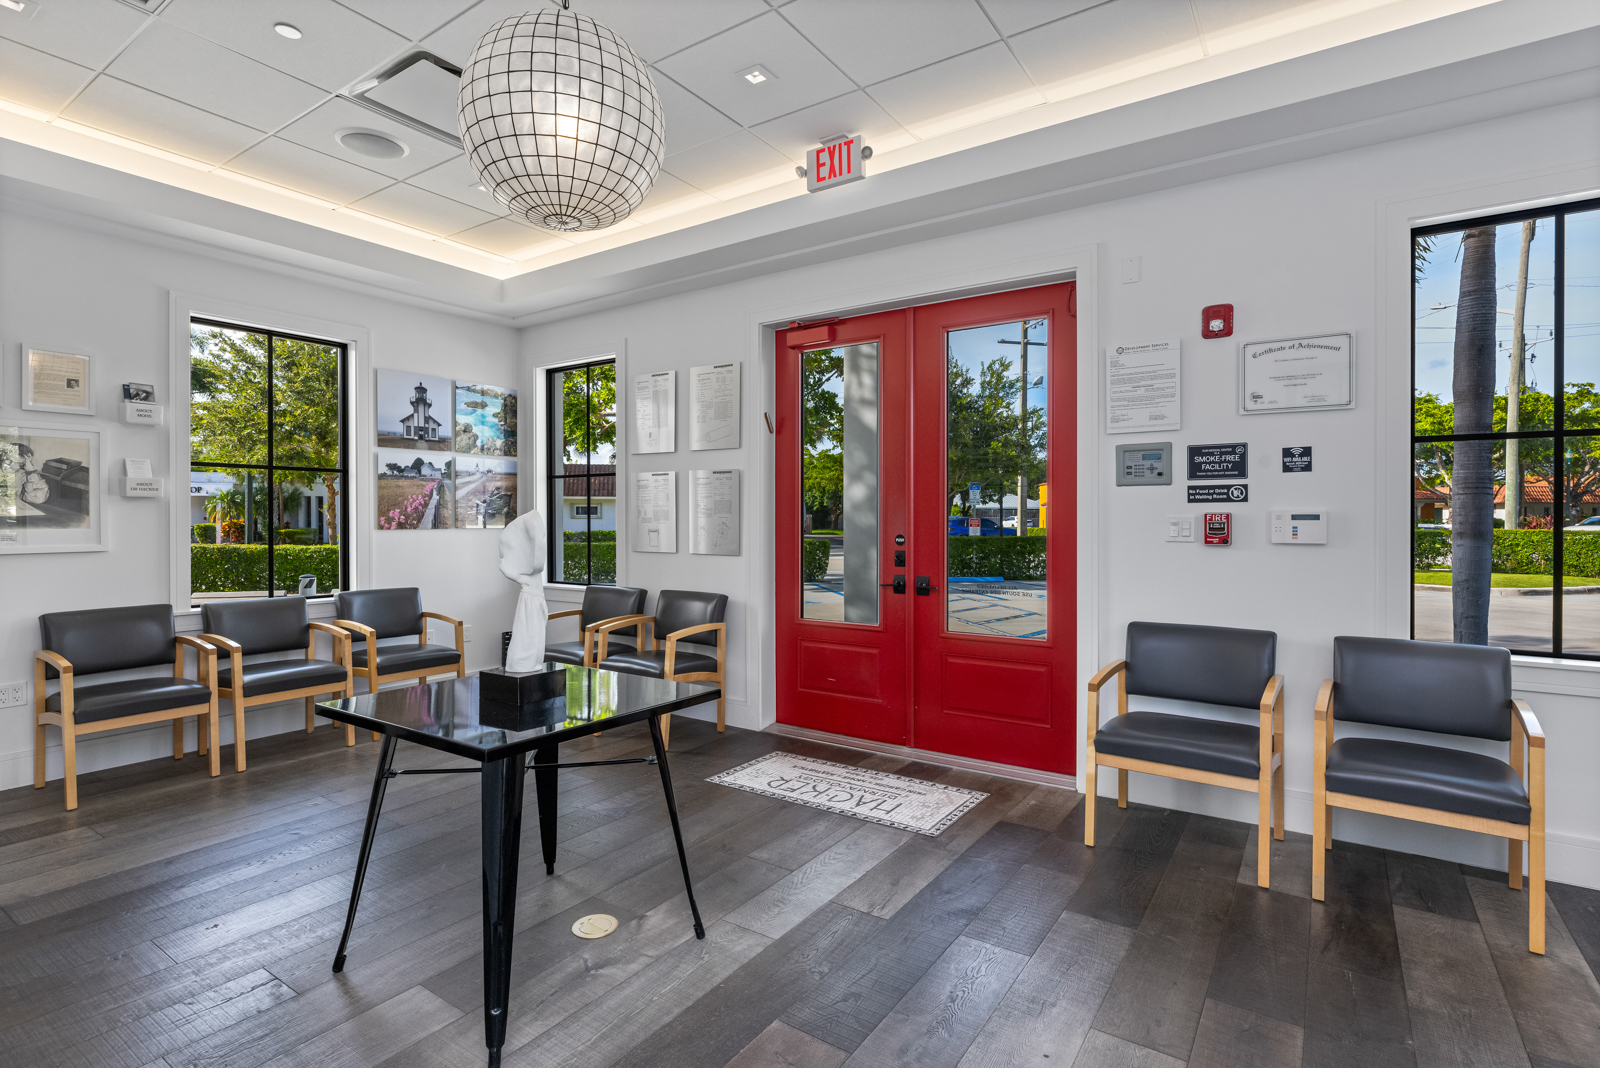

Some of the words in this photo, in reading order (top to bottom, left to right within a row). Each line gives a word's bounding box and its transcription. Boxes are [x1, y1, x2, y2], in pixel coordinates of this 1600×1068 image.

[816, 139, 854, 183] EXIT
[1124, 344, 1151, 352] DEVELOPMENT
[1252, 345, 1287, 359] Certificate
[1295, 342, 1341, 352] Achievement
[1194, 454, 1241, 463] SMOKE-FREE
[767, 777, 903, 814] HACKER
[795, 775, 899, 800] DERMATOLOGY
